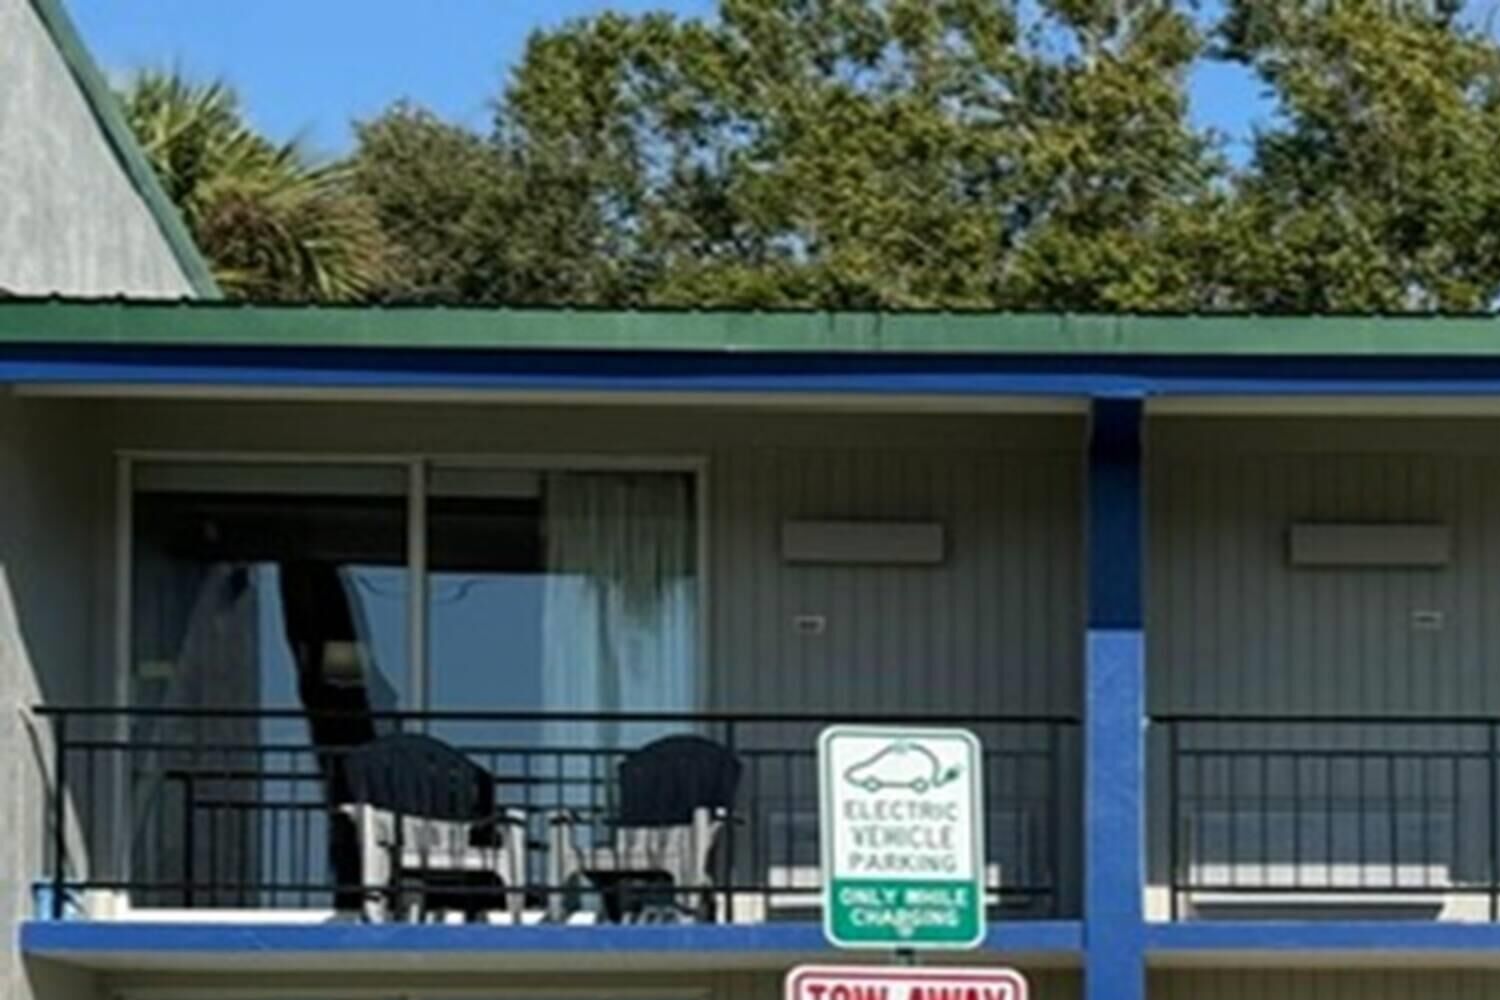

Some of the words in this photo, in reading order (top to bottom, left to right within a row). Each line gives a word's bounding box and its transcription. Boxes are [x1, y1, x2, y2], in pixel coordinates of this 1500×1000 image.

[844, 800, 959, 821] ELECTRIC
[850, 825, 955, 849] VEHICLE
[849, 854, 956, 873] PARKING
[839, 887, 896, 906] ONLY
[905, 887, 968, 907] WHILE
[849, 908, 959, 927] CHARGING
